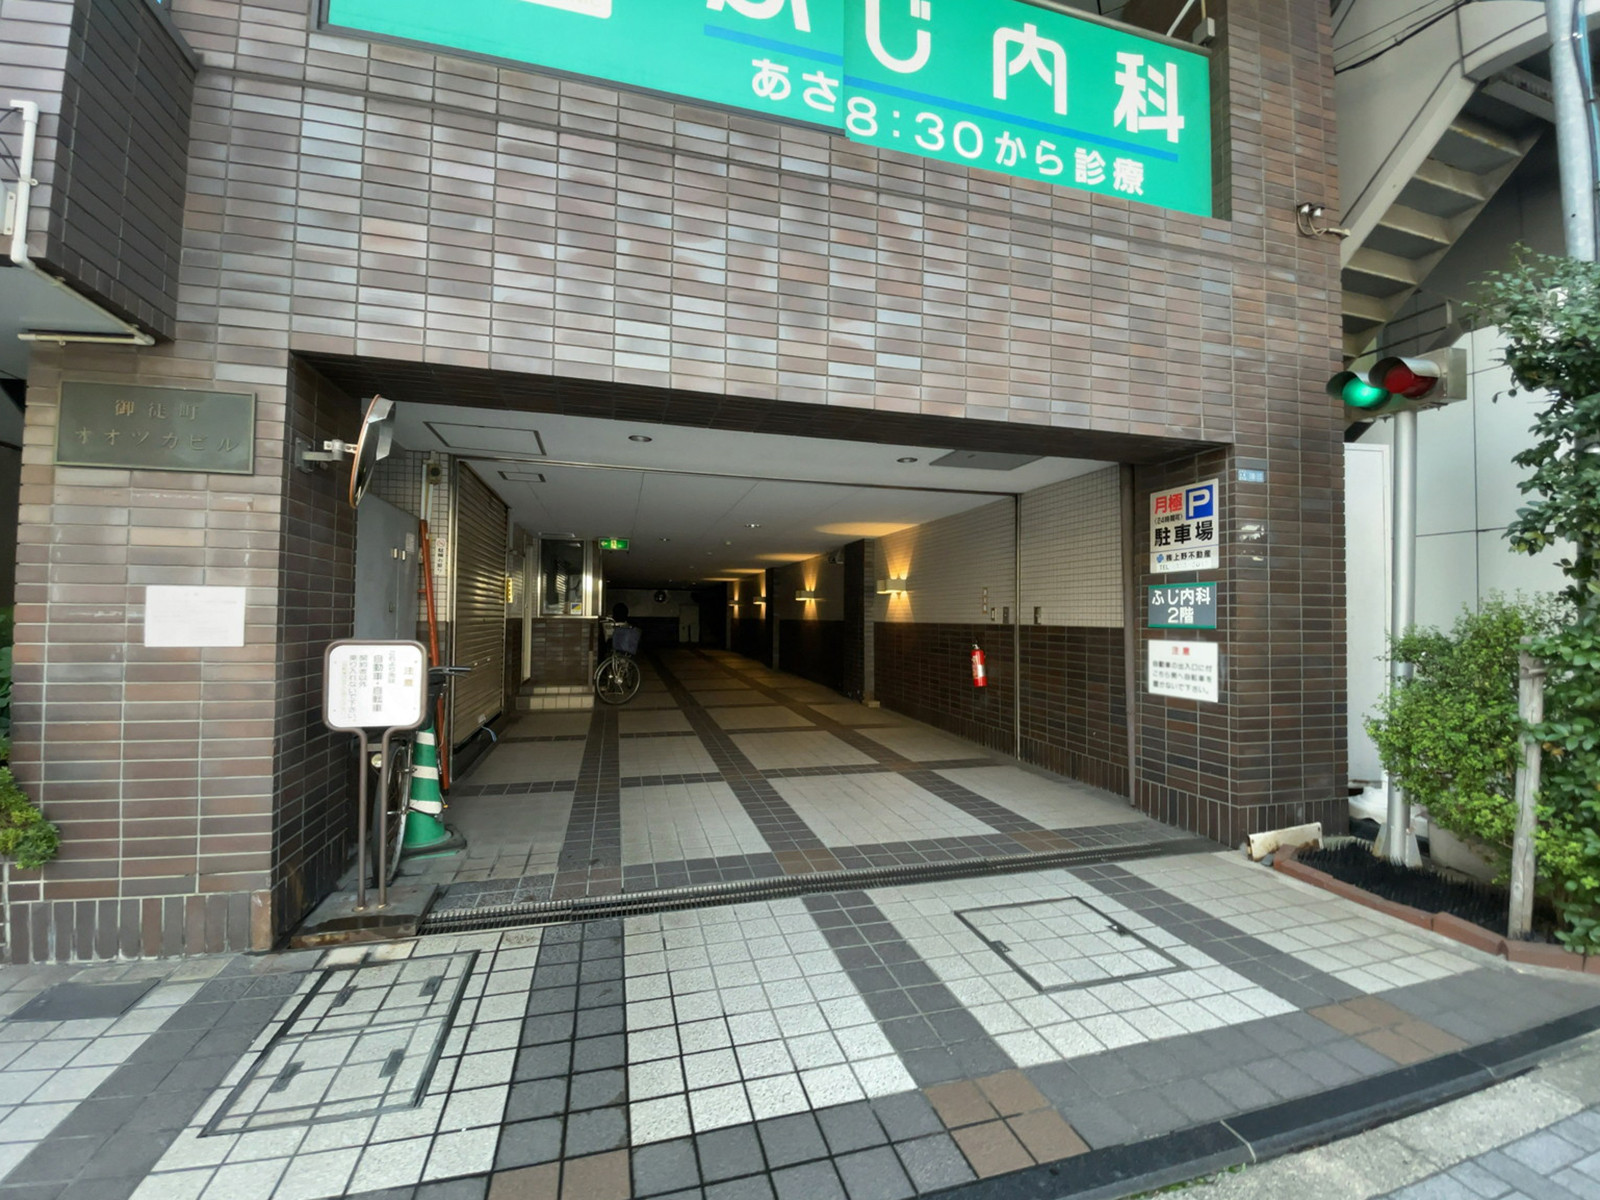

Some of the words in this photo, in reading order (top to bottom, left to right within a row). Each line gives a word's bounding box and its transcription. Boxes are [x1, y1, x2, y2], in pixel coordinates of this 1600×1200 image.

[115, 399, 199, 420] 御徒町
[75, 427, 239, 452] オオツカビル
[1155, 492, 1183, 514] 月極
[1188, 488, 1210, 517] P
[1154, 520, 1213, 547] 駐車場
[1152, 586, 1211, 605] ふじ内科
[1167, 606, 1194, 625] 2階
[1171, 646, 1190, 656] 注意
